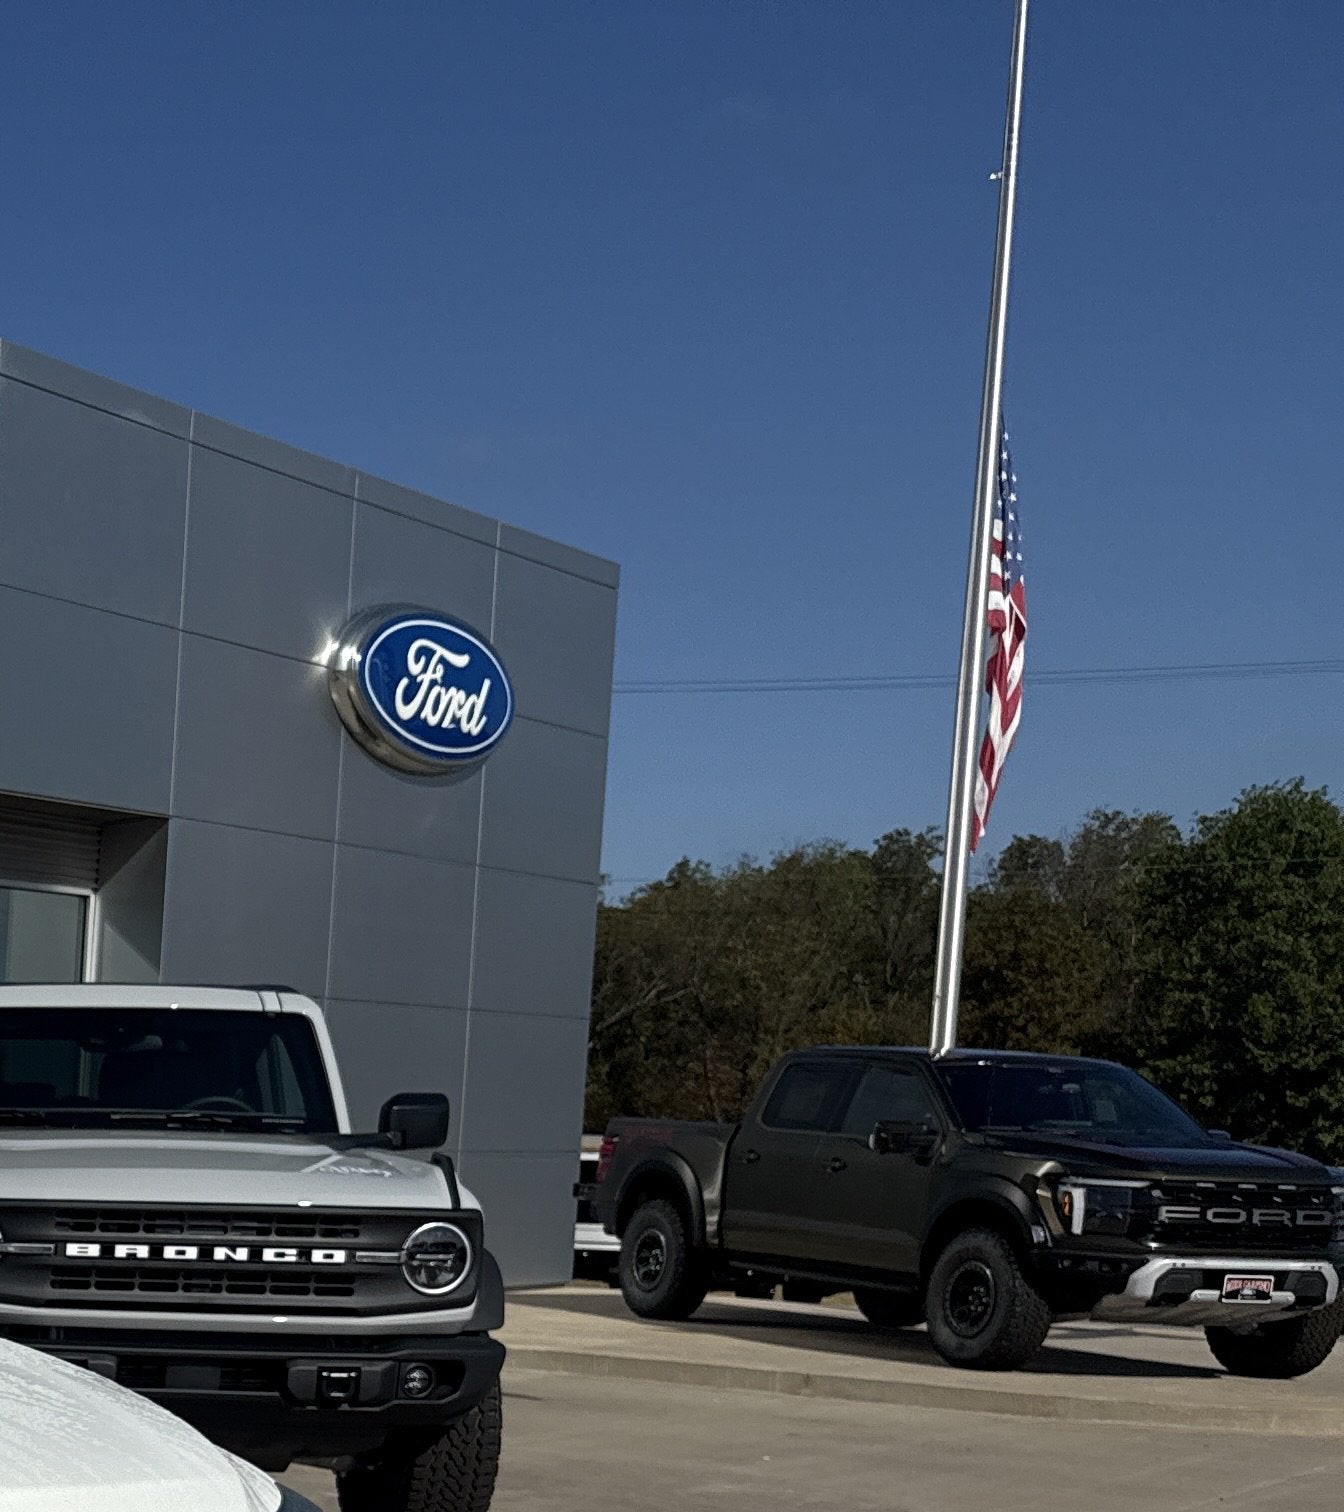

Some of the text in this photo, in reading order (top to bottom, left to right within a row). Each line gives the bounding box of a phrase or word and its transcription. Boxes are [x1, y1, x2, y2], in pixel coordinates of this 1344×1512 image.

[395, 638, 492, 737] Ford
[1157, 1205, 1332, 1229] FORD
[65, 1243, 346, 1264] BRONCO
